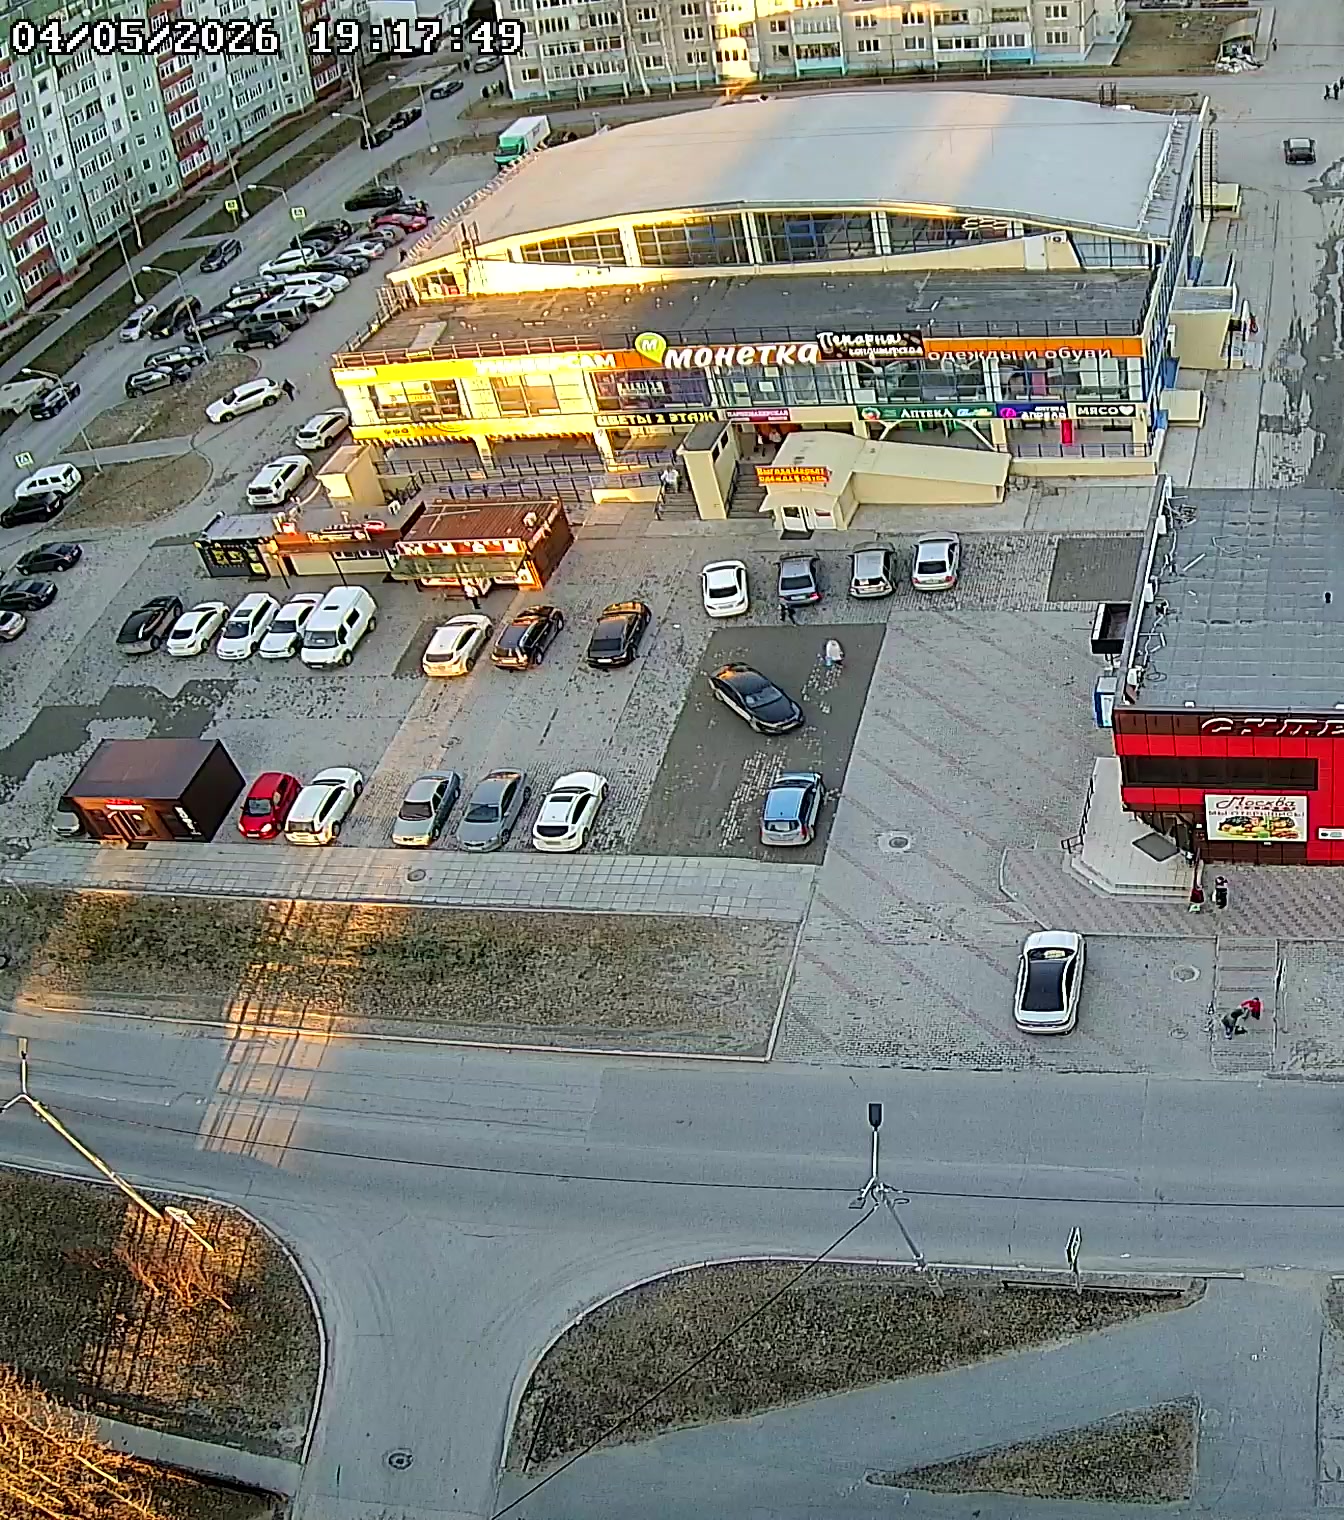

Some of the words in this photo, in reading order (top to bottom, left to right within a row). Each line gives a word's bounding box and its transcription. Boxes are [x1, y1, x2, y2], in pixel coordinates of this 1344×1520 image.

[1044, 346, 1111, 362] обуви
[655, 414, 666, 424] 2
[668, 411, 717, 424] ЭТАЖ
[1077, 406, 1119, 416] МЯСО
[1216, 796, 1297, 809] Москва
